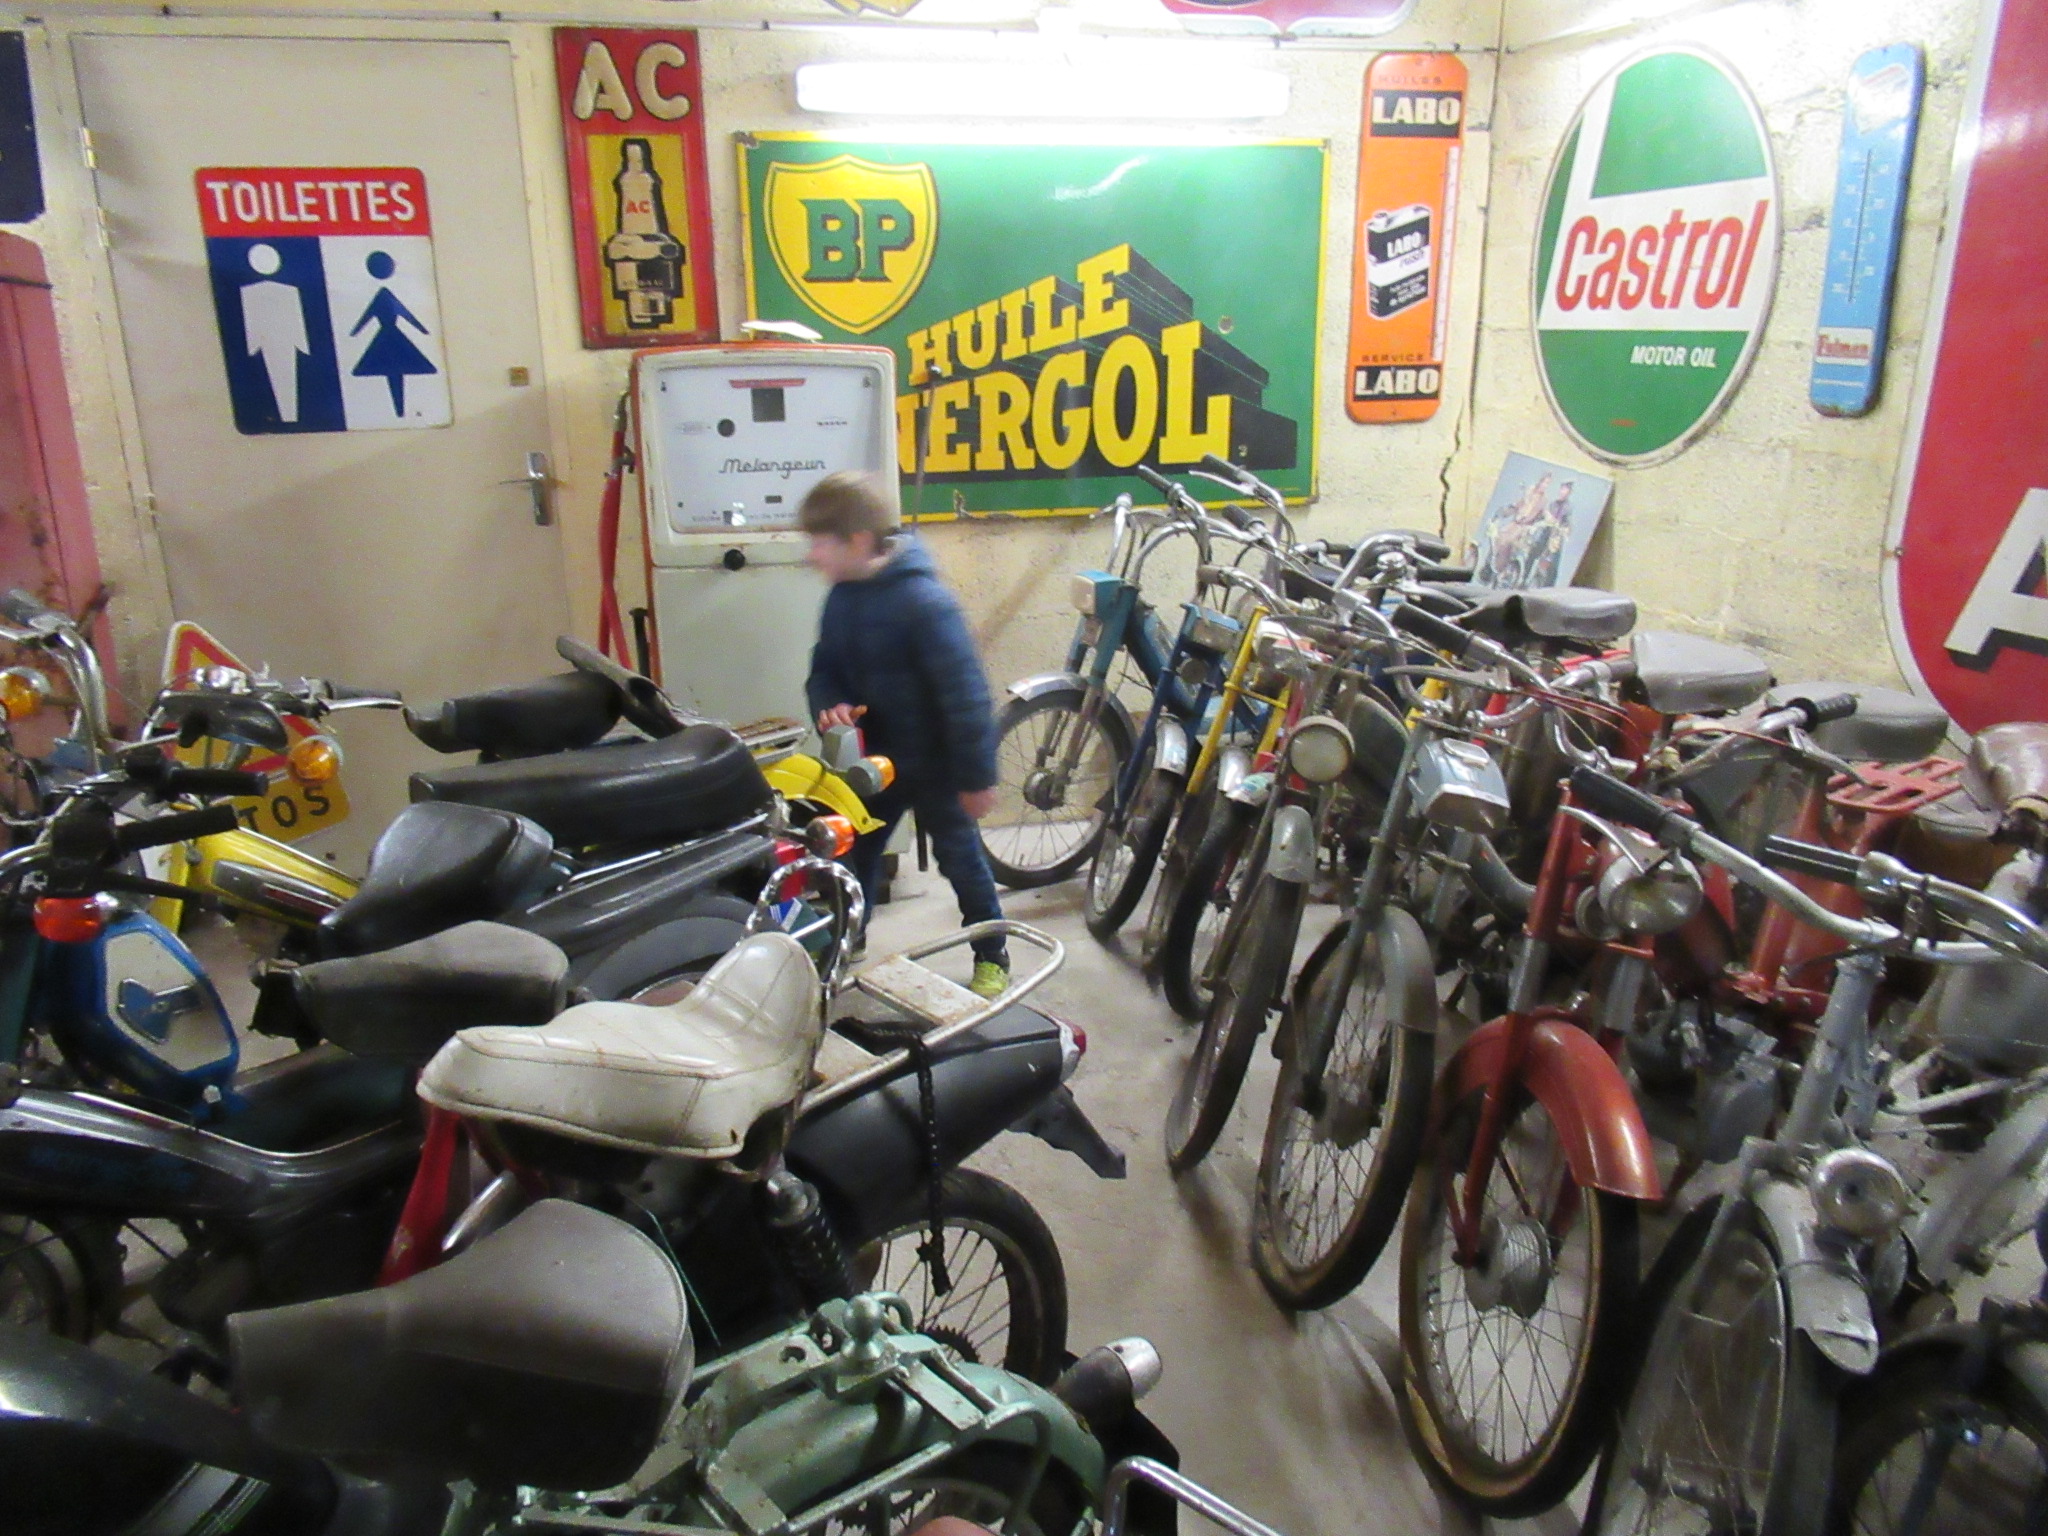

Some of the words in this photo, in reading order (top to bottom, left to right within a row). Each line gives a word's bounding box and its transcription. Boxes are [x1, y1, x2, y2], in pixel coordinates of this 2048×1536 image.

[571, 39, 692, 121] AC
[1371, 96, 1461, 125] LABO
[206, 180, 416, 224] TOILETTES
[625, 200, 651, 214] AC
[799, 198, 916, 283] BP
[1554, 199, 1770, 313] Castrol
[907, 244, 1131, 386] HUILE
[1630, 345, 1688, 366] MOTOR
[1690, 346, 1717, 368] OIL
[1355, 368, 1440, 395] LABO
